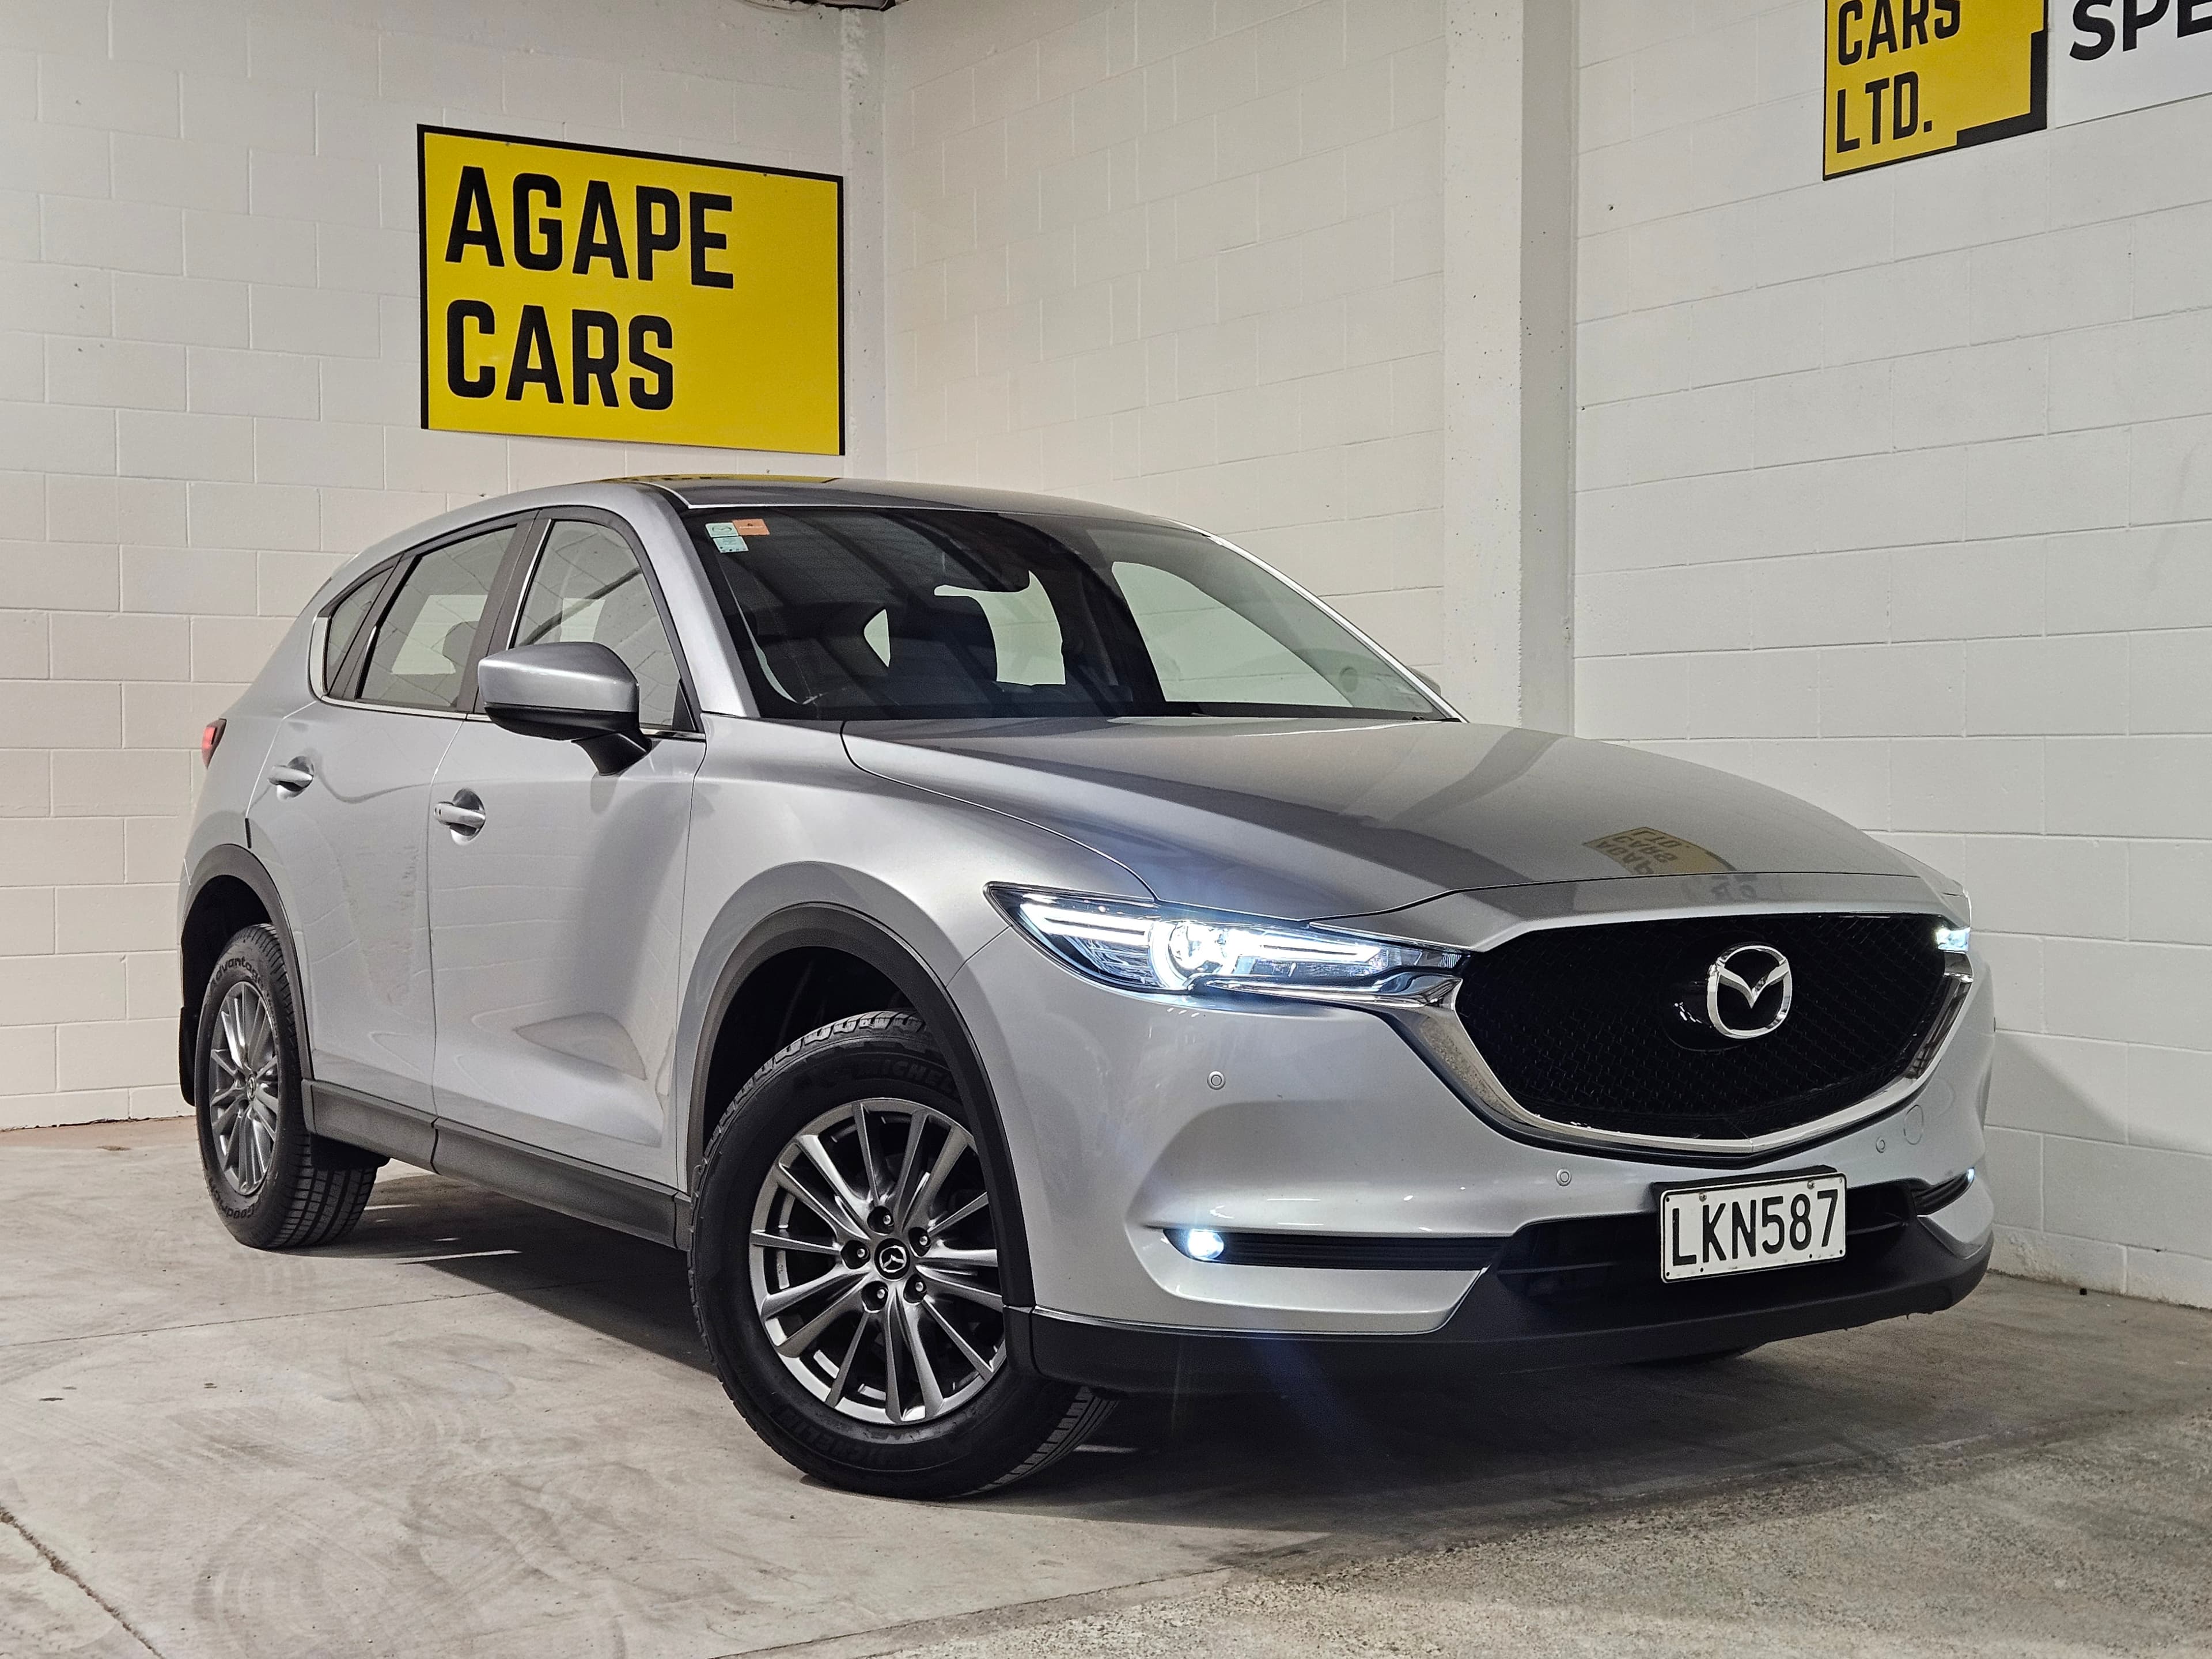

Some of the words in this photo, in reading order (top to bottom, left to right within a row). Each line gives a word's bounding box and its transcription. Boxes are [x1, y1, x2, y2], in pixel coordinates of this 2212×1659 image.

[1838, 0, 1960, 66] CARS
[1836, 71, 1932, 153] LTD.
[445, 165, 733, 289] AGAPE
[446, 300, 673, 410] CARS
[1672, 1189, 1838, 1266] LKN587
